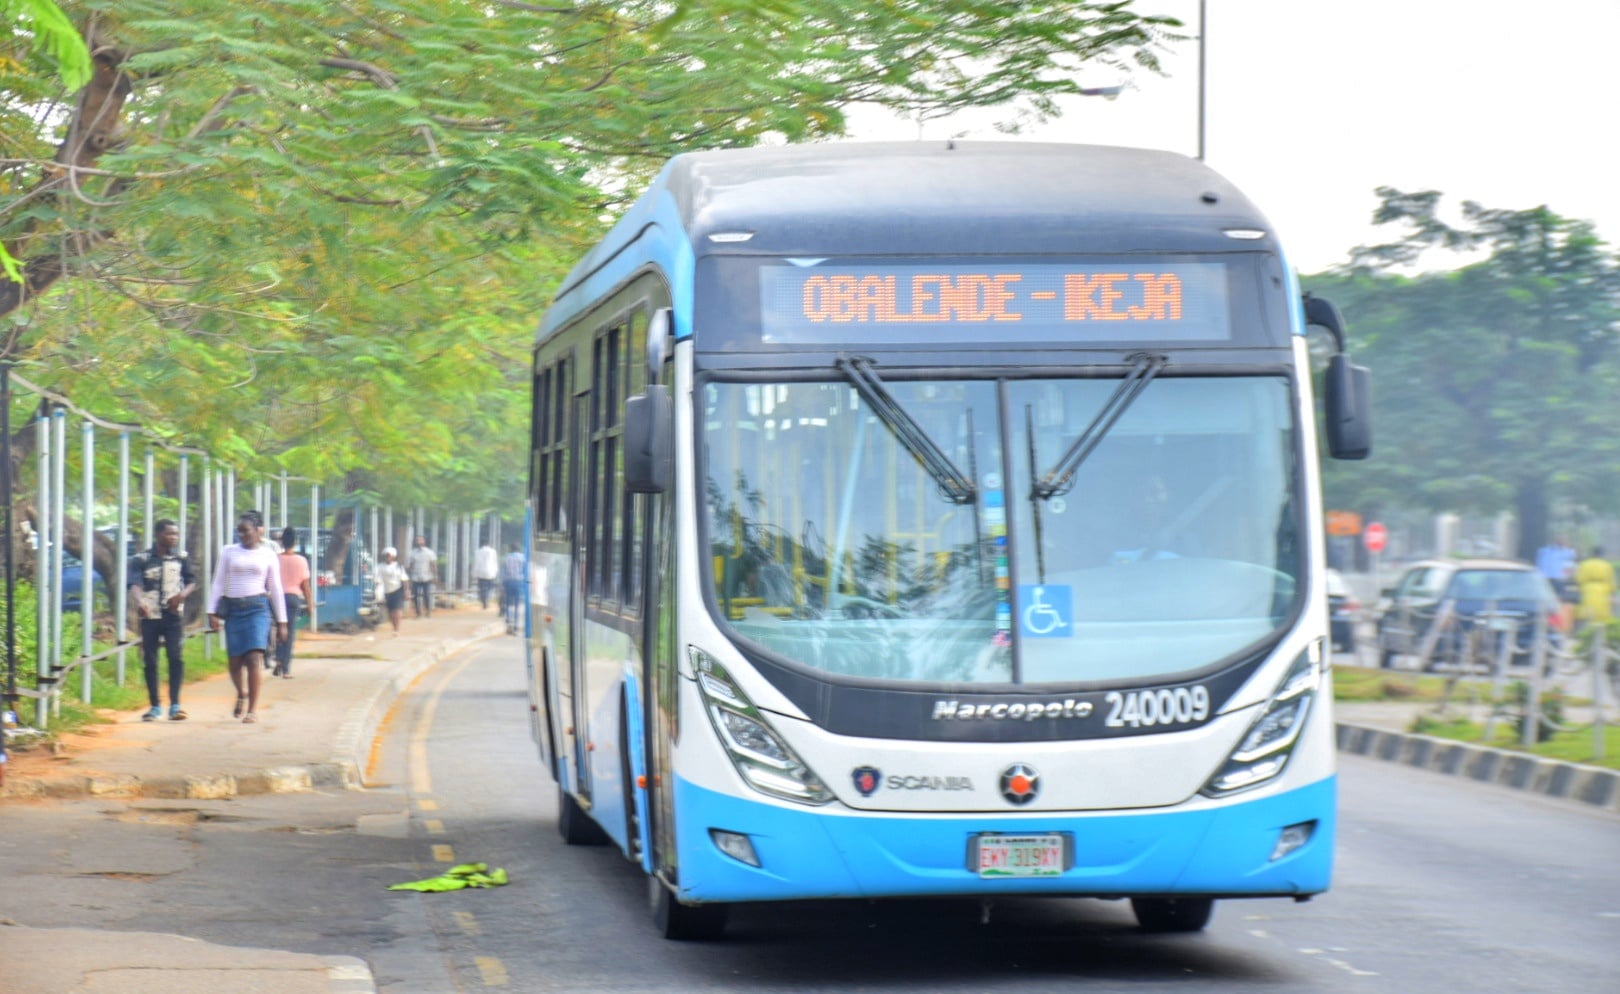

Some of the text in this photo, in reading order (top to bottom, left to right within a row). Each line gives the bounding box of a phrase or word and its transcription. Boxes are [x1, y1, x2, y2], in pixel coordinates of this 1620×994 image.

[803, 275, 1022, 321] OBALENDE
[932, 699, 1093, 721] Marcopolo
[1105, 686, 1209, 728] 240009
[887, 775, 975, 791] SCANIA
